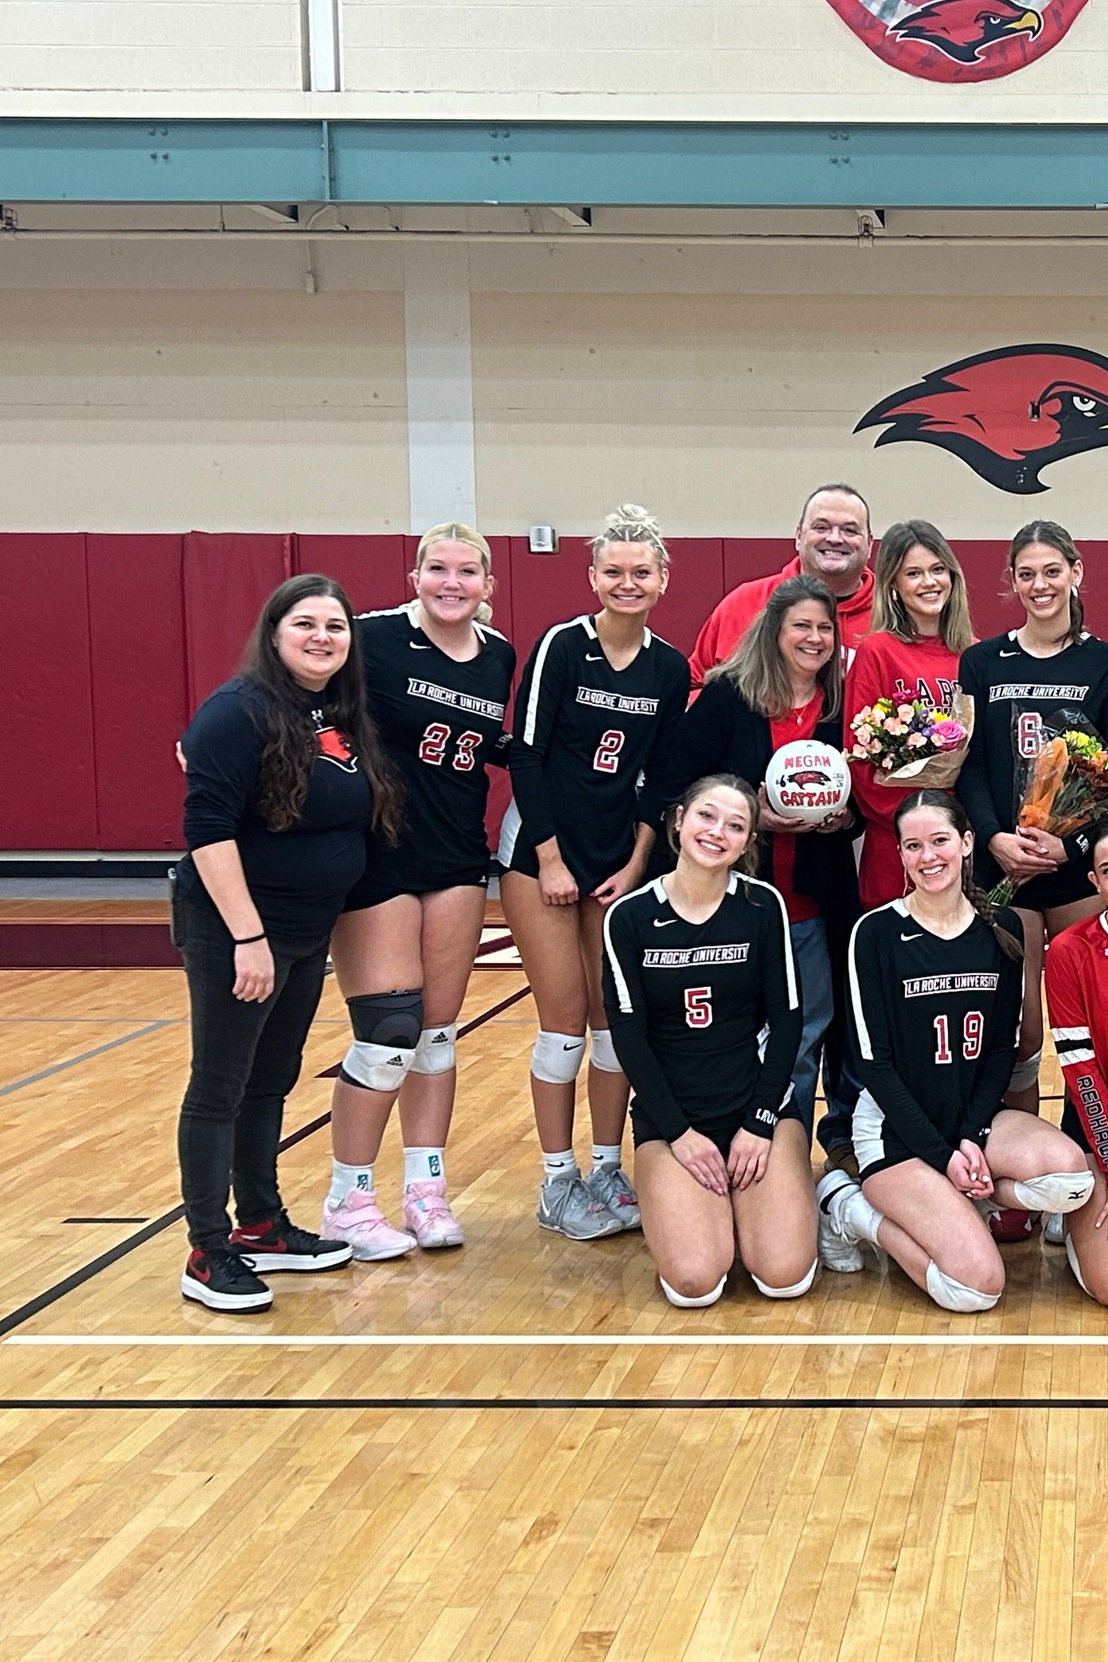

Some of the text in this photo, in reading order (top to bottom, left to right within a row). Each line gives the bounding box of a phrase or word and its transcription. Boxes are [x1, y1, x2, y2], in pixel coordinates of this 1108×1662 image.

[411, 682, 427, 695] LA
[426, 686, 458, 705] ROCHE
[1001, 686, 1031, 697] ROCHE
[1032, 686, 1086, 698] UNIVERSITY
[418, 722, 484, 772] 23
[593, 729, 626, 774] 2
[1018, 712, 1043, 759] 6
[646, 952, 660, 965] LA
[659, 951, 692, 965] ROCHE
[684, 985, 713, 1028] 5
[907, 981, 920, 995] LA
[921, 977, 952, 993] ROCHE
[933, 1010, 985, 1065] 19
